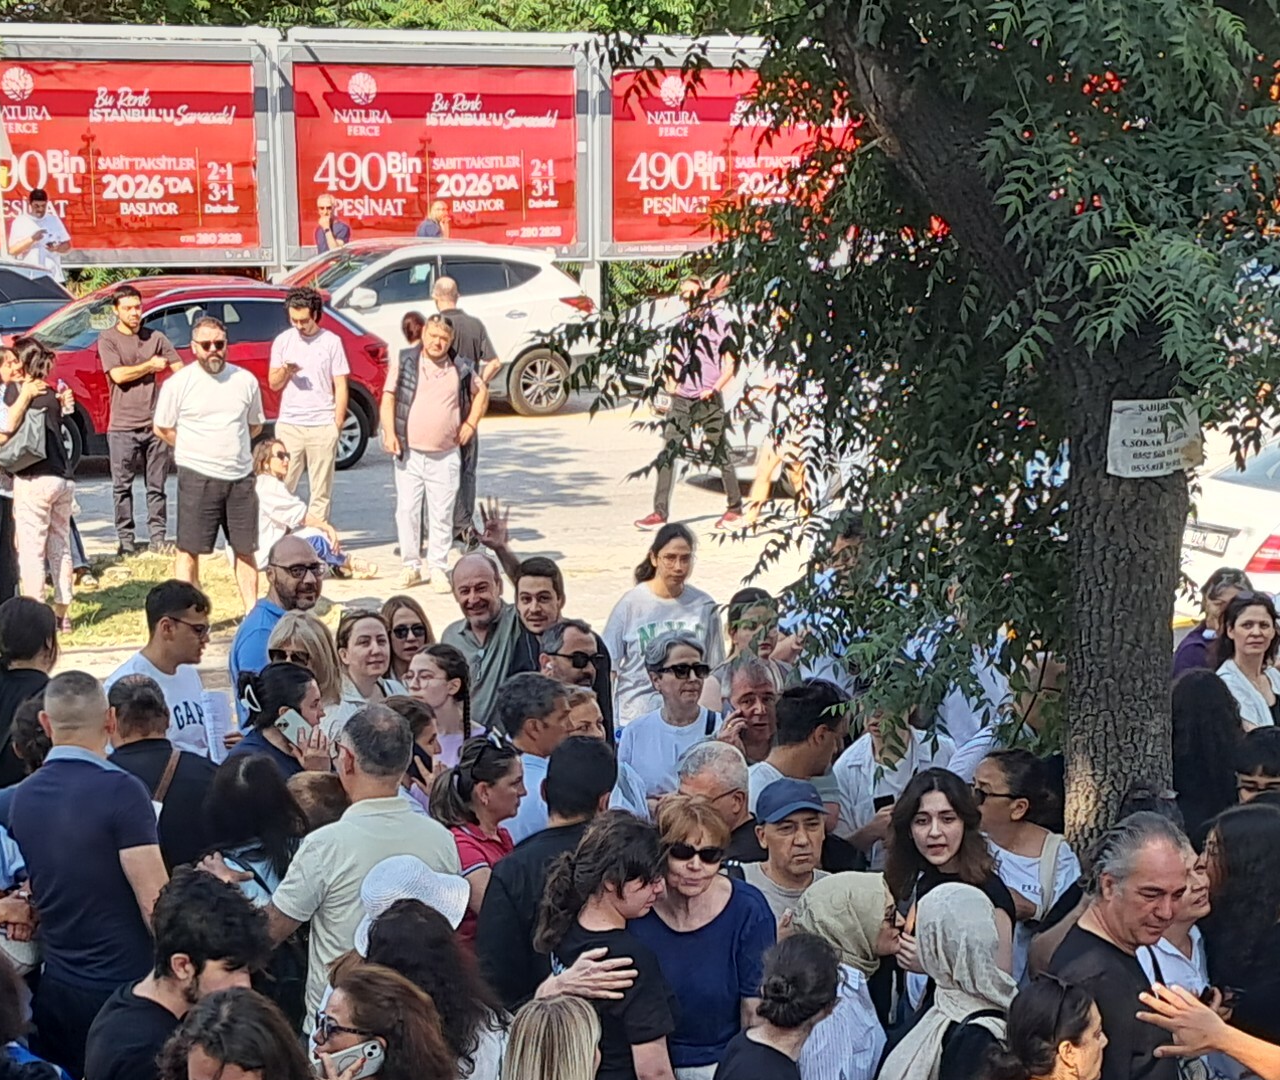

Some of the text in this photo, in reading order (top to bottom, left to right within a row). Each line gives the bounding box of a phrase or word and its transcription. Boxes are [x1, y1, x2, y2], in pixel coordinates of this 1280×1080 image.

[1, 105, 52, 120] ATURA
[333, 108, 392, 124] NATURA
[646, 111, 700, 125] NATURA
[347, 125, 380, 137] FERCE
[658, 127, 688, 137] FERCE
[47, 149, 86, 174] Bin
[207, 161, 233, 181] 2+1
[530, 159, 554, 177] 2+1
[627, 150, 726, 191] 490 Bin
[313, 151, 422, 192] 490 Bin
[52, 173, 82, 194] TL
[392, 173, 419, 193] TL
[531, 179, 555, 196] 3+1
[698, 172, 721, 191] TL
[208, 182, 234, 201] 3+1
[333, 195, 406, 220] PEŞİNAT
